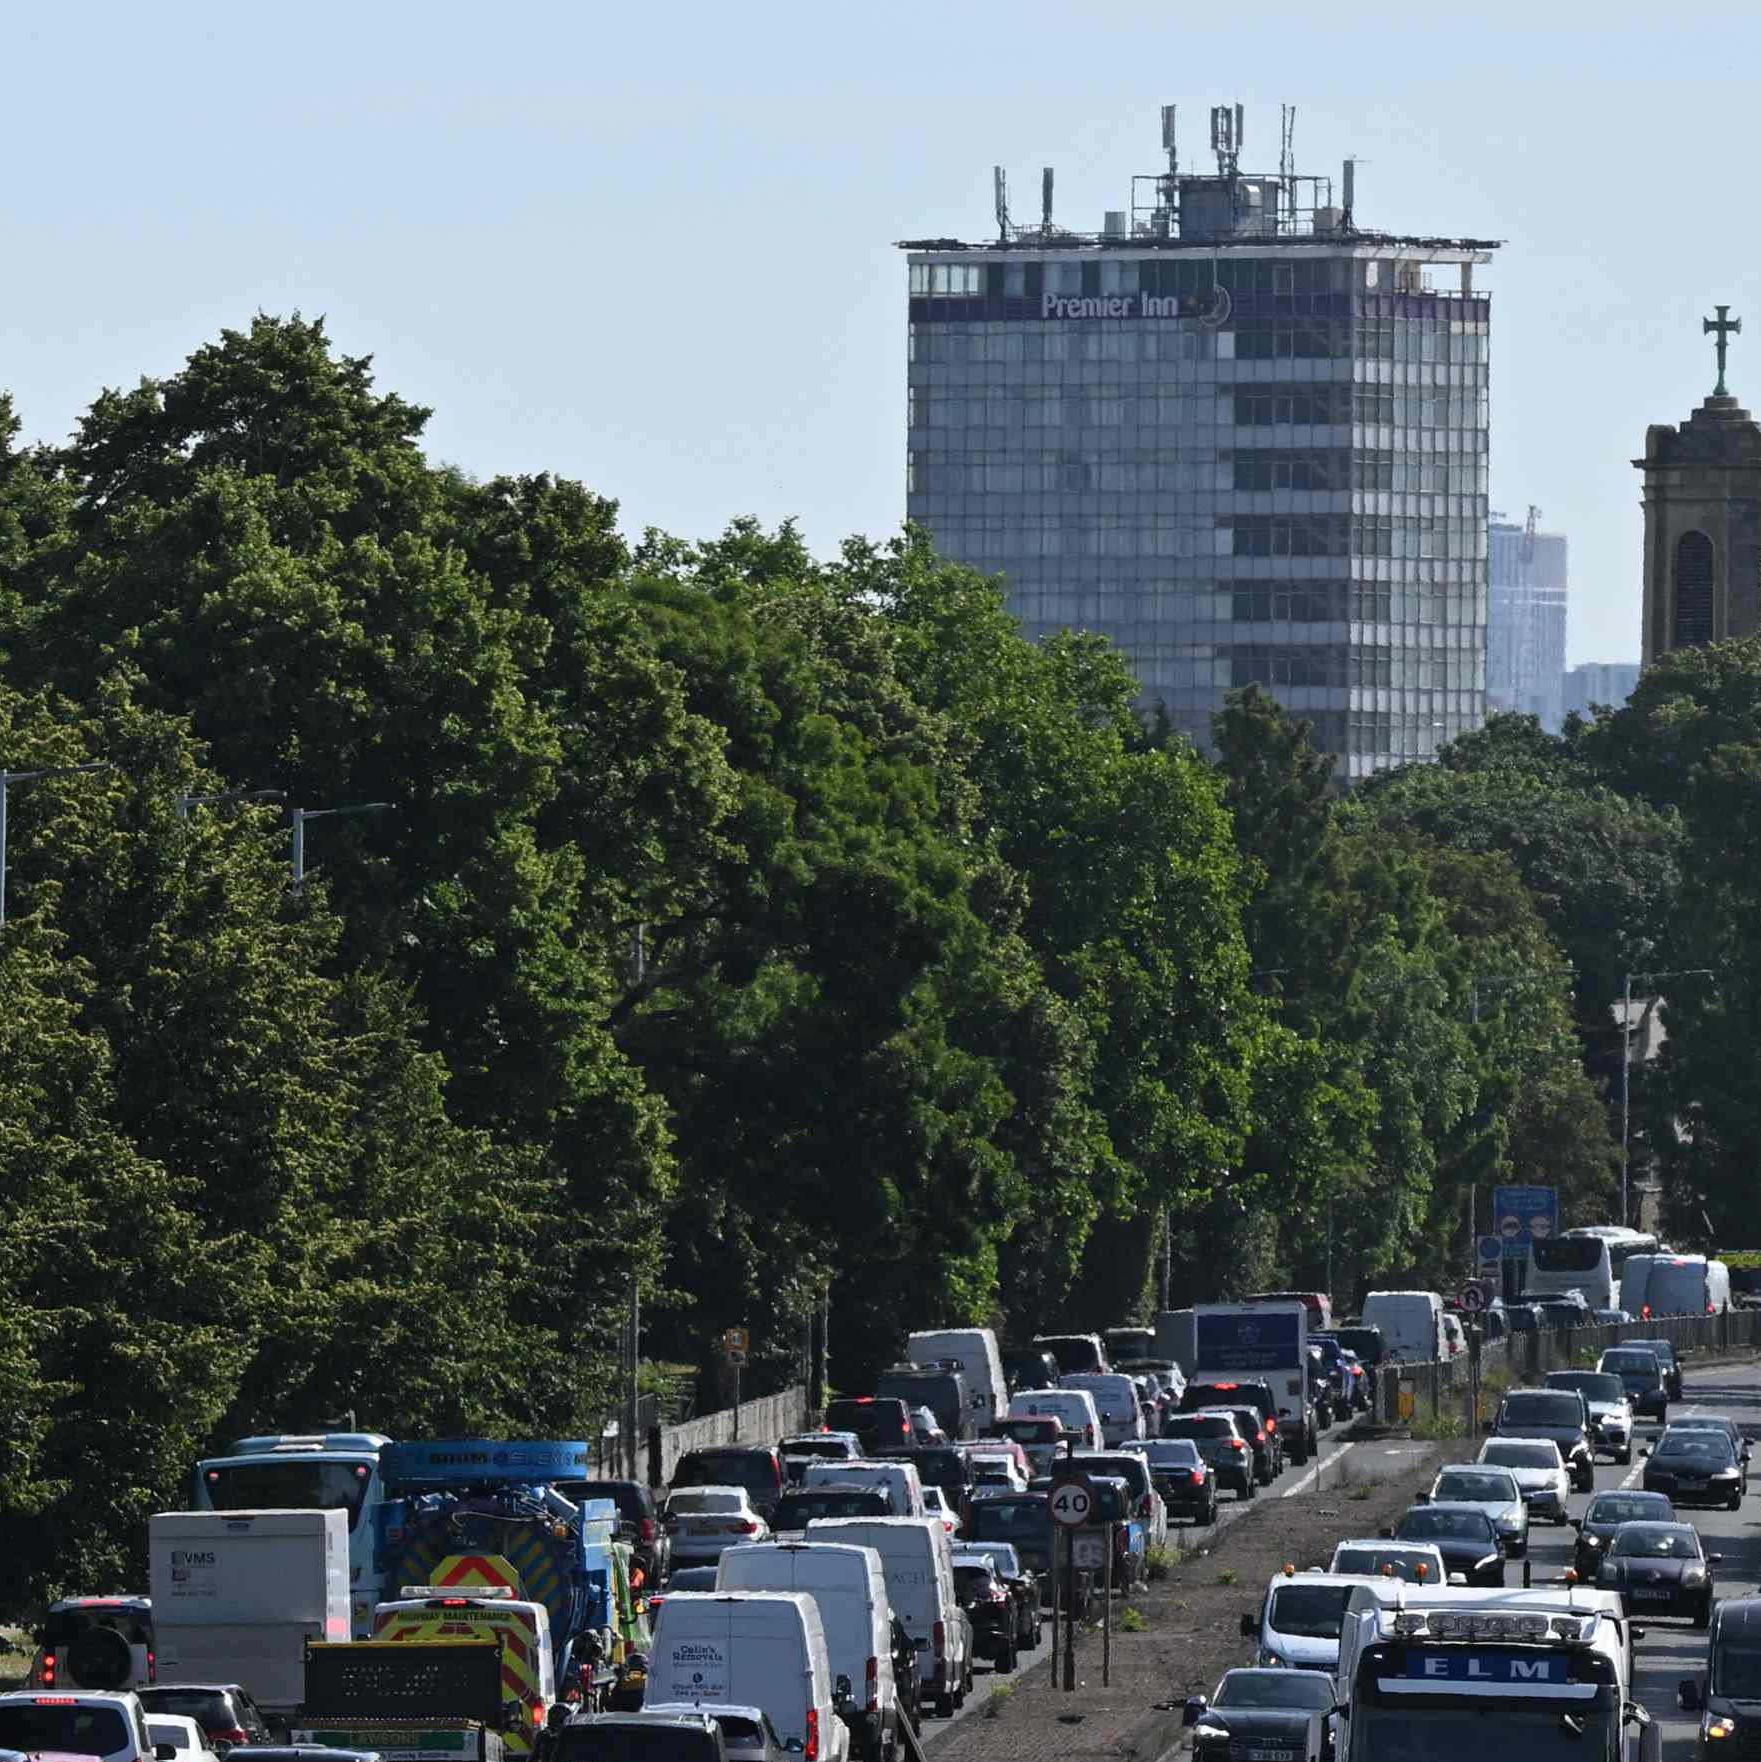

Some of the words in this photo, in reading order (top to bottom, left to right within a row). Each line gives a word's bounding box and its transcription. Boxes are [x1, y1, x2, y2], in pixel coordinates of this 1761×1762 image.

[1041, 292, 1135, 320] Premier
[1140, 292, 1178, 317] Inn
[1054, 1494, 1088, 1513] 40
[443, 1611, 512, 1622] MAINTENANCE
[680, 1645, 716, 1654] Colin's
[672, 1651, 724, 1662] Removals
